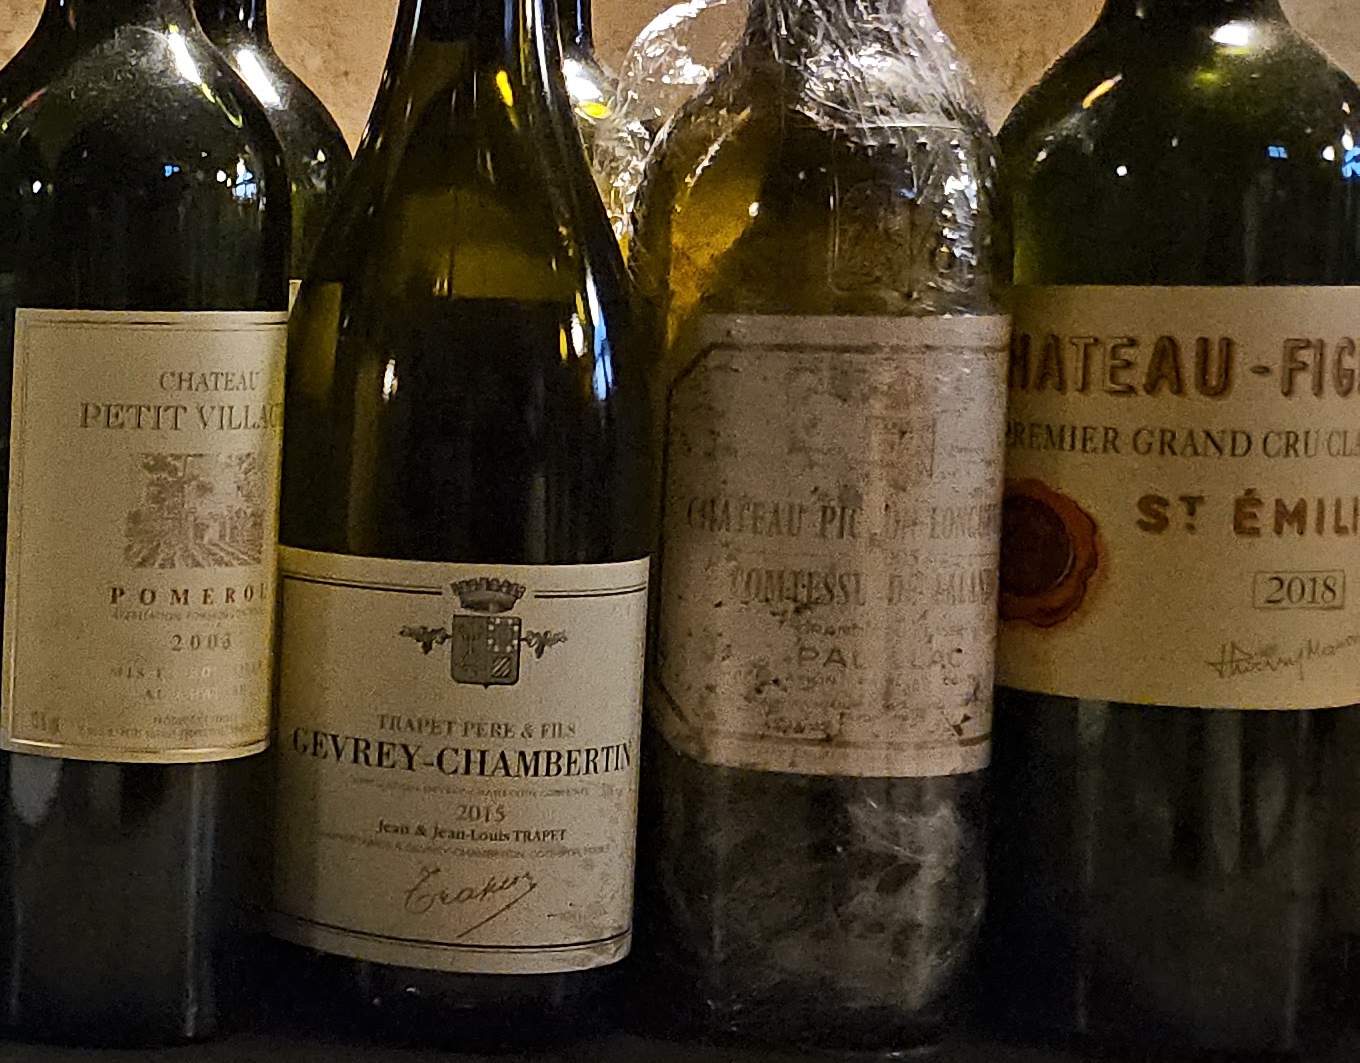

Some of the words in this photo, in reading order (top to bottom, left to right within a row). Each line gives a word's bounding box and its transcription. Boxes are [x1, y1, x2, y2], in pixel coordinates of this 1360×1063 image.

[1281, 336, 1360, 398] FIG
[159, 371, 260, 392] CHATEAU
[79, 402, 187, 431] PETIT
[1132, 426, 1252, 458] GRAND
[1262, 429, 1321, 459] CRU
[110, 582, 268, 606] POMEROL
[1265, 576, 1337, 605] 2018
[379, 713, 458, 736] TRAPET
[456, 803, 506, 824] 2015
[375, 818, 410, 836] Jean
